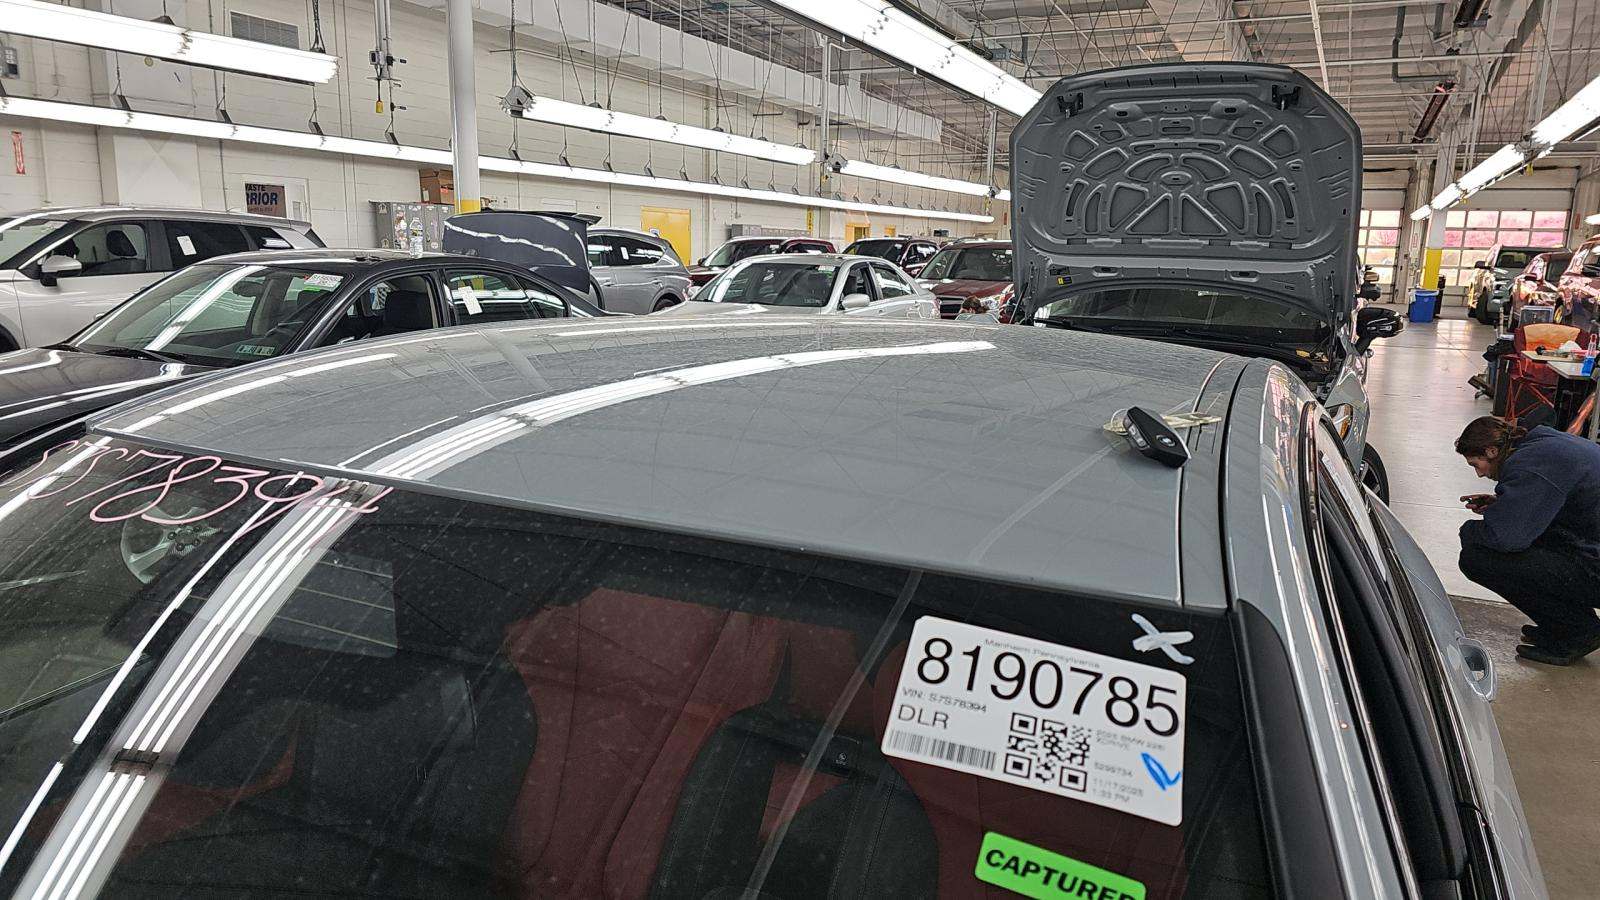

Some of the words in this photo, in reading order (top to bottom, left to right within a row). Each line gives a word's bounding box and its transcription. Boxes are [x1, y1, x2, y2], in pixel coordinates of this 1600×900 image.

[1033, 648, 1101, 669] Pennsylvania
[917, 637, 1180, 737] 8190785
[898, 703, 950, 730] DLR
